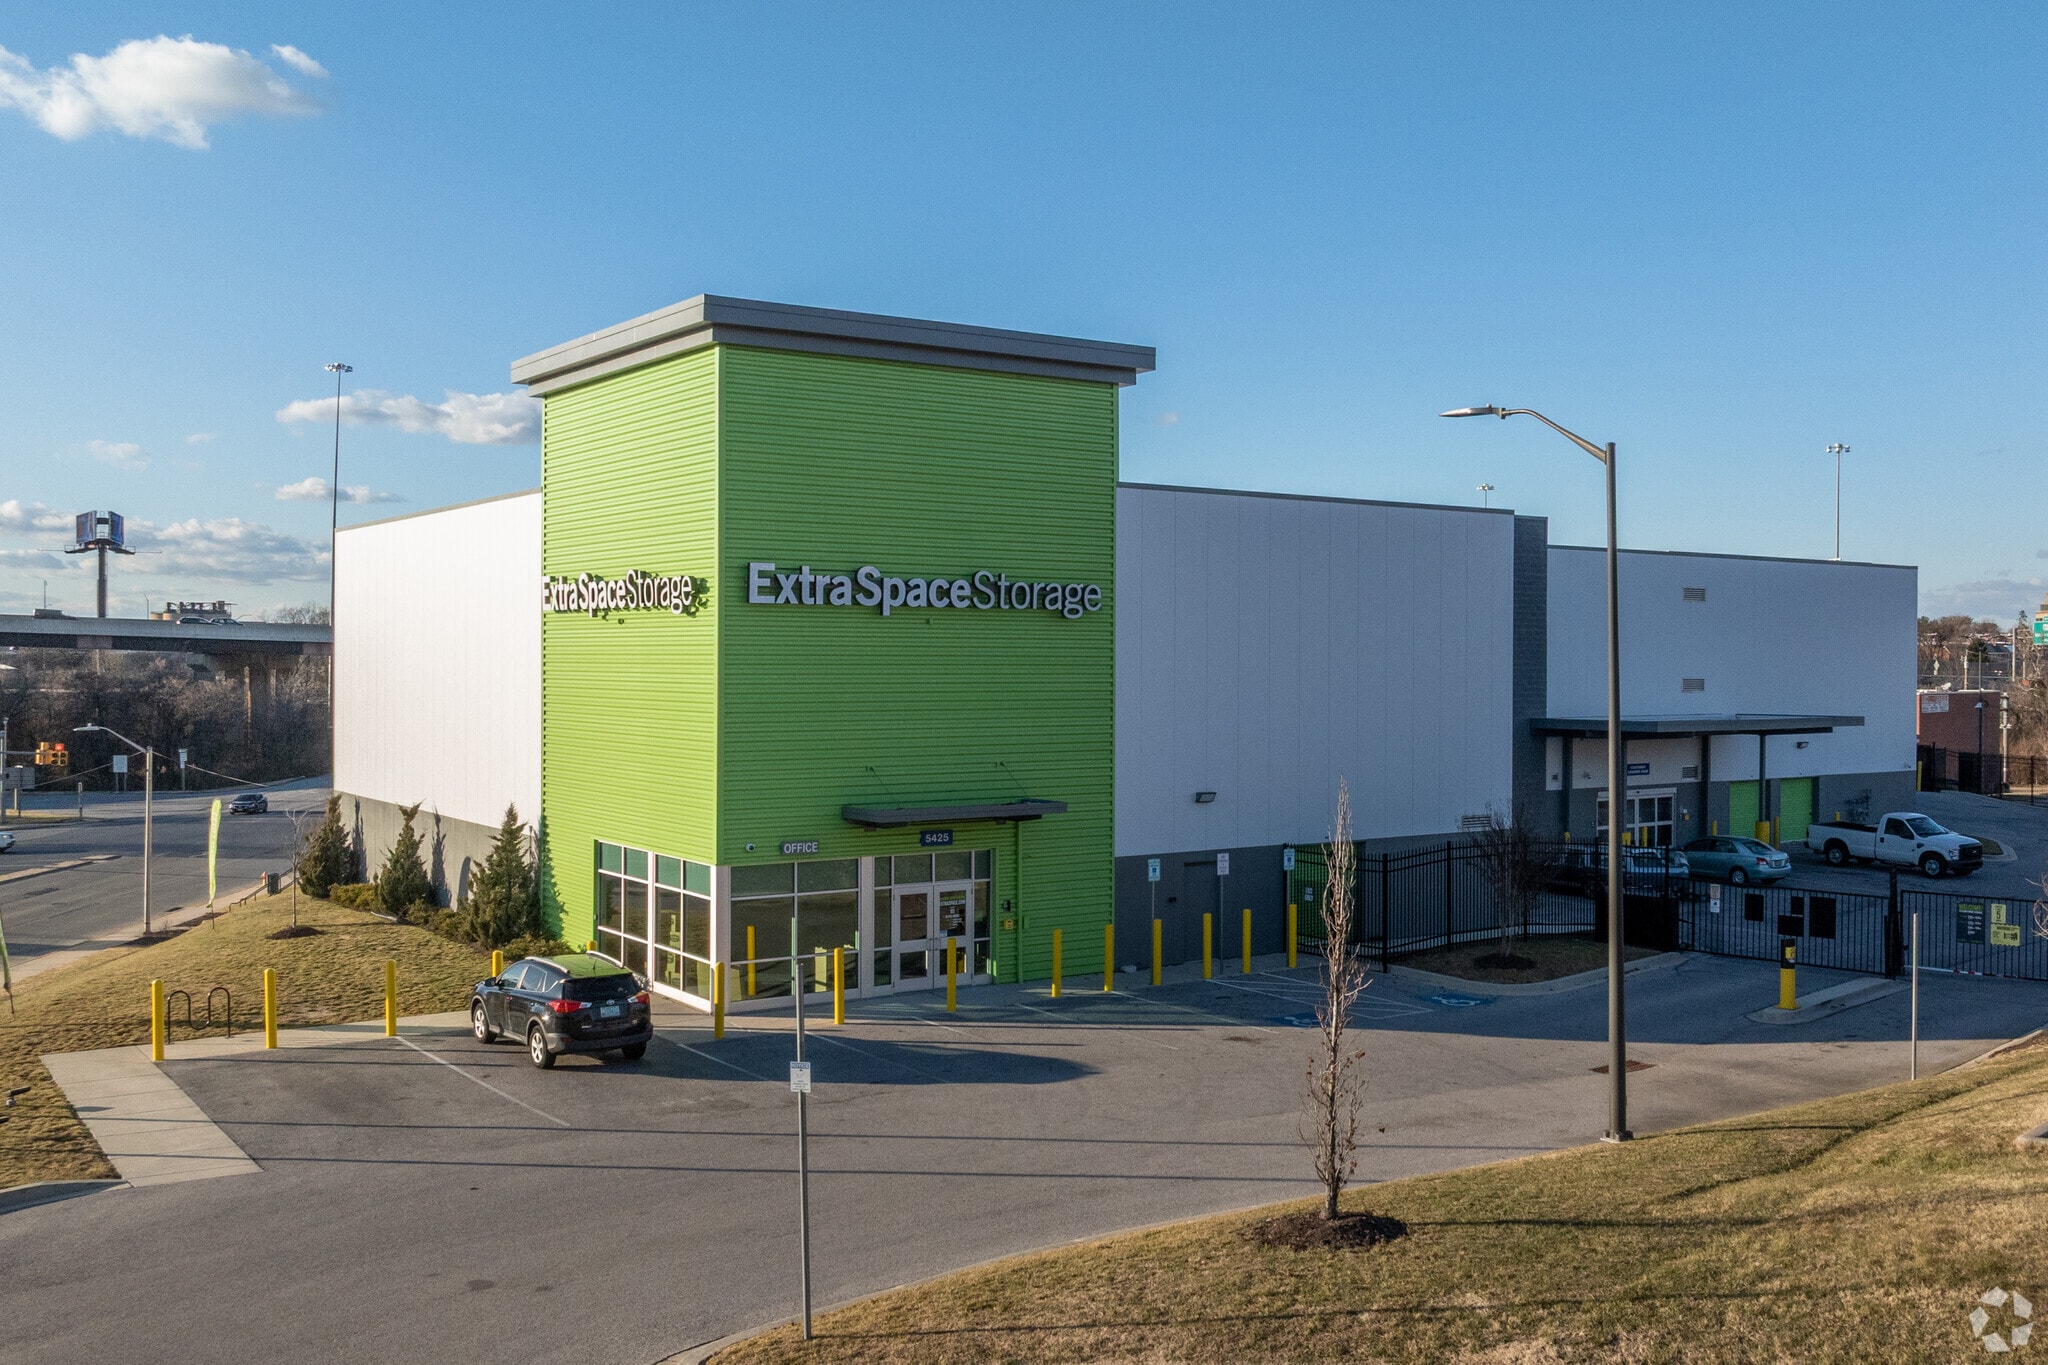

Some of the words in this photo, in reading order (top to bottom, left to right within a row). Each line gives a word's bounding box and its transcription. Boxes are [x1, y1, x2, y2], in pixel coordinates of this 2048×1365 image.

[925, 833, 949, 843] 5425
[783, 842, 819, 854] OFFICE
[1996, 910, 2001, 919] 5
